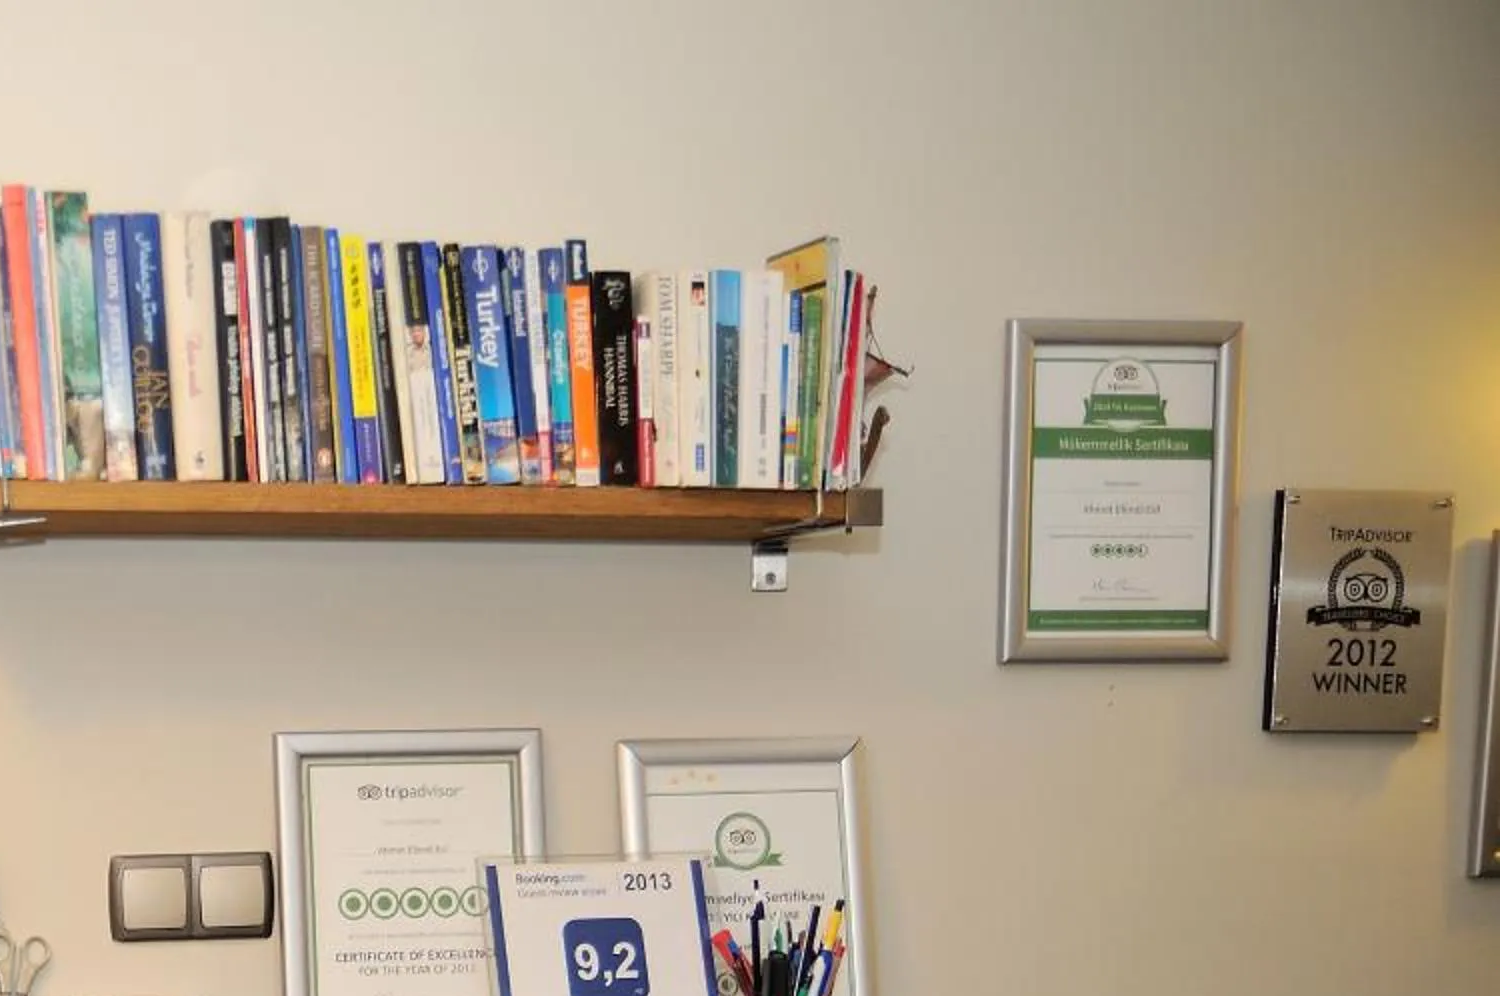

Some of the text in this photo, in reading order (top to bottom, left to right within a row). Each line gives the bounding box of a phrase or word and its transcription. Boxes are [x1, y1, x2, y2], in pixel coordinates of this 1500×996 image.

[475, 285, 501, 368] Turkey
[572, 296, 591, 371] TURKEY
[658, 276, 674, 382] TOM SHARPE
[455, 345, 479, 426] Turkish
[603, 347, 616, 410] HANNIBAL
[615, 335, 629, 427] THOMAS HARRIS
[1327, 639, 1398, 668] 2012
[1312, 671, 1408, 695] WINNER
[384, 783, 461, 801] tripadvisor
[623, 873, 673, 892] 2013
[335, 950, 406, 964] CERTIFICATE
[409, 949, 426, 962] OF
[357, 966, 379, 978] FOR
[383, 965, 401, 977] THE
[405, 964, 431, 976] YEAR
[574, 941, 640, 988] 9,2
